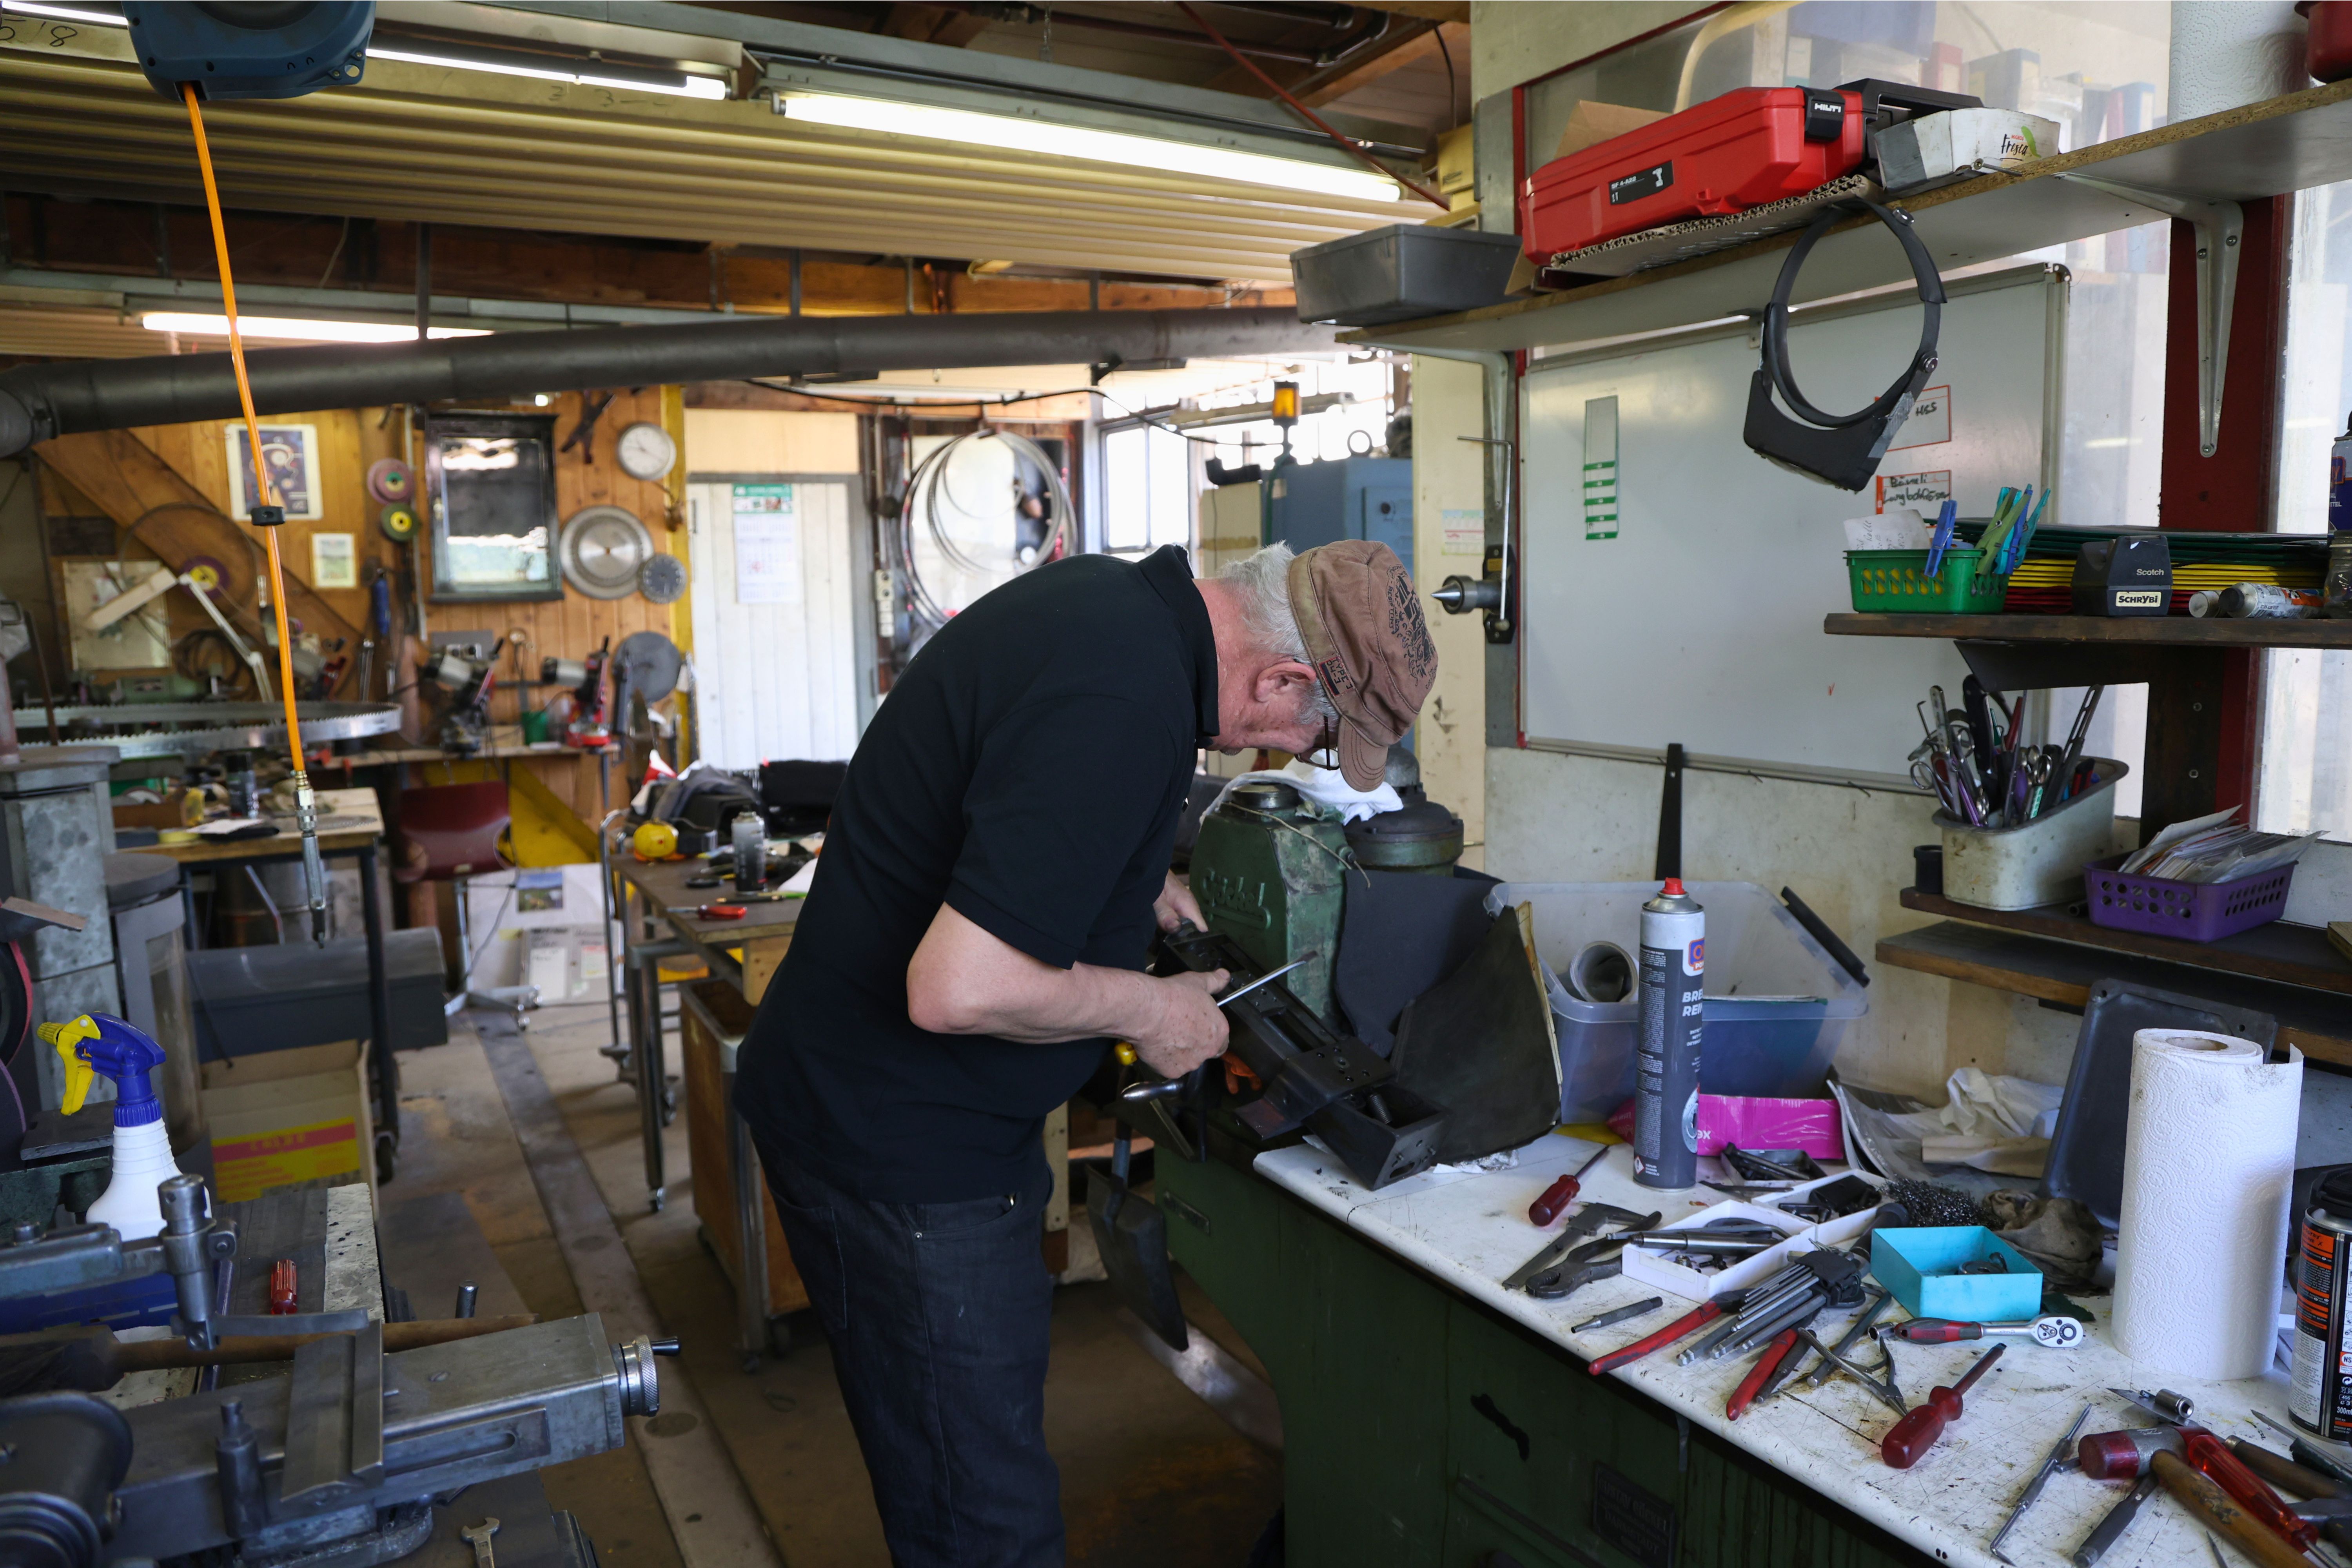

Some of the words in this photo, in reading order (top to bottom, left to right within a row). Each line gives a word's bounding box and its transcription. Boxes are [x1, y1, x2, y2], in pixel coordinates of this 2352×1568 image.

[1814, 103, 1841, 113] HILTI
[2001, 134, 2029, 156] Fresca
[1620, 176, 1637, 186] 4-A22
[1916, 401, 1937, 416] HSS
[1333, 659, 1349, 682] TYPE
